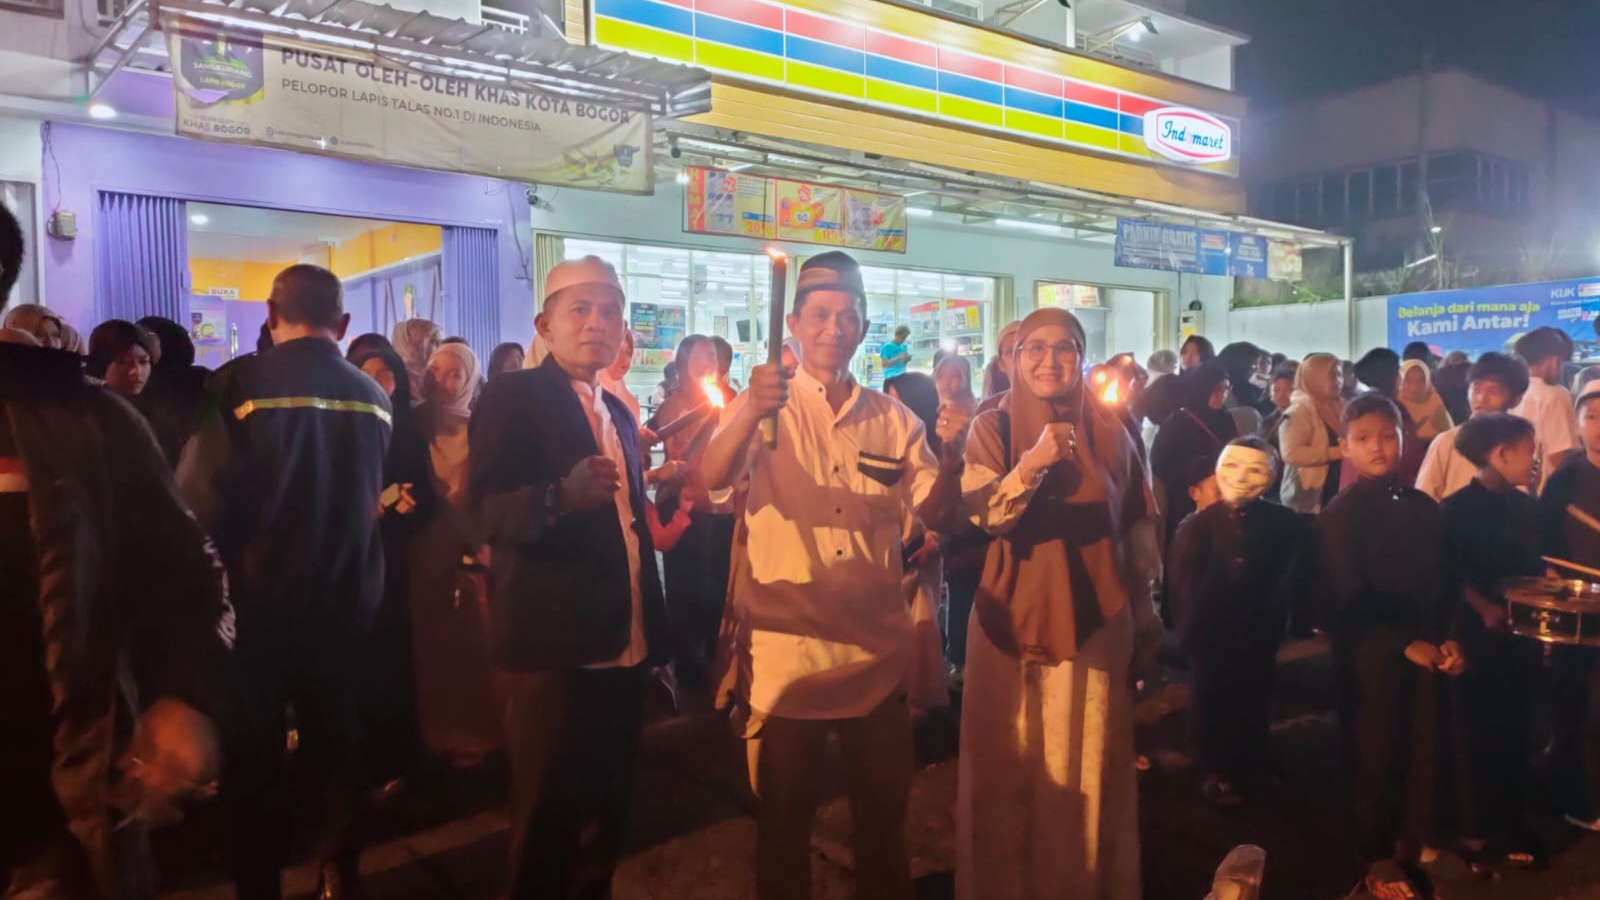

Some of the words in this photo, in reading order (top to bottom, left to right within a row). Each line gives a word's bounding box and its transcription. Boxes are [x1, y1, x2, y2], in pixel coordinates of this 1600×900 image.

[283, 49, 346, 75] PUSAT
[355, 62, 469, 97] OLEH-OLEH
[475, 87, 521, 107] KHAS
[525, 94, 571, 116] KOTA
[576, 103, 630, 124] BOGOR
[282, 79, 347, 99] PELOPOR
[352, 91, 388, 107] LAPIS
[391, 97, 430, 114] TALAS
[433, 107, 460, 121] NO.1
[463, 111, 476, 122] DI
[478, 113, 541, 132] INDONESIA
[213, 124, 251, 135] BOGOR
[1399, 303, 1445, 318] Belanja
[1447, 301, 1475, 314] dari
[1477, 303, 1516, 312] mana
[1518, 301, 1541, 314] aja
[1407, 315, 1459, 337] Kami
[1462, 313, 1530, 331] Antar!
